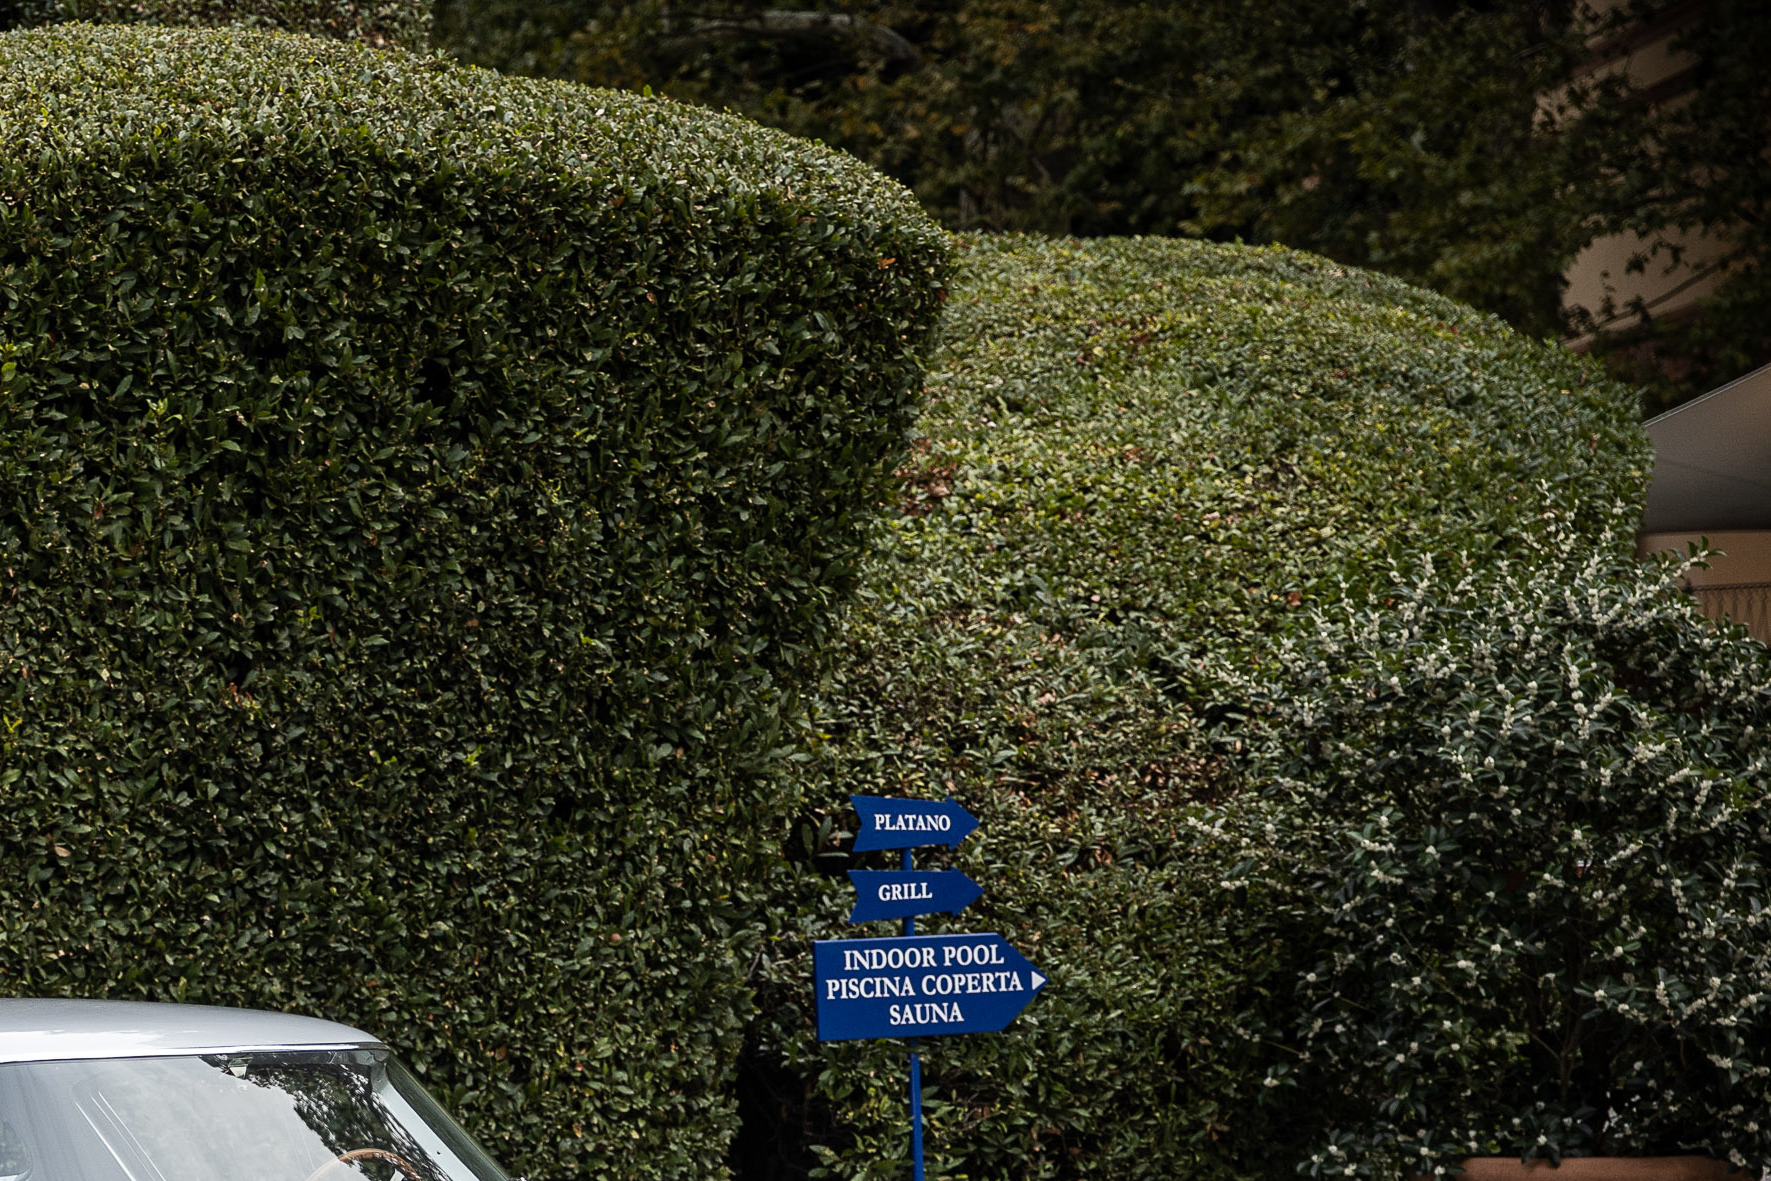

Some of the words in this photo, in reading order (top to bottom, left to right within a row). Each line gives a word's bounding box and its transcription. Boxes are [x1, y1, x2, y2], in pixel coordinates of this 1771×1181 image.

[874, 813, 951, 831] PLATANO
[878, 882, 933, 901] GRILL
[844, 947, 937, 970] INDOOR
[943, 944, 1004, 966] POOL
[826, 976, 916, 1000] PISCINA
[921, 971, 1024, 996] COPERTA
[889, 1002, 964, 1026] SAUNA
